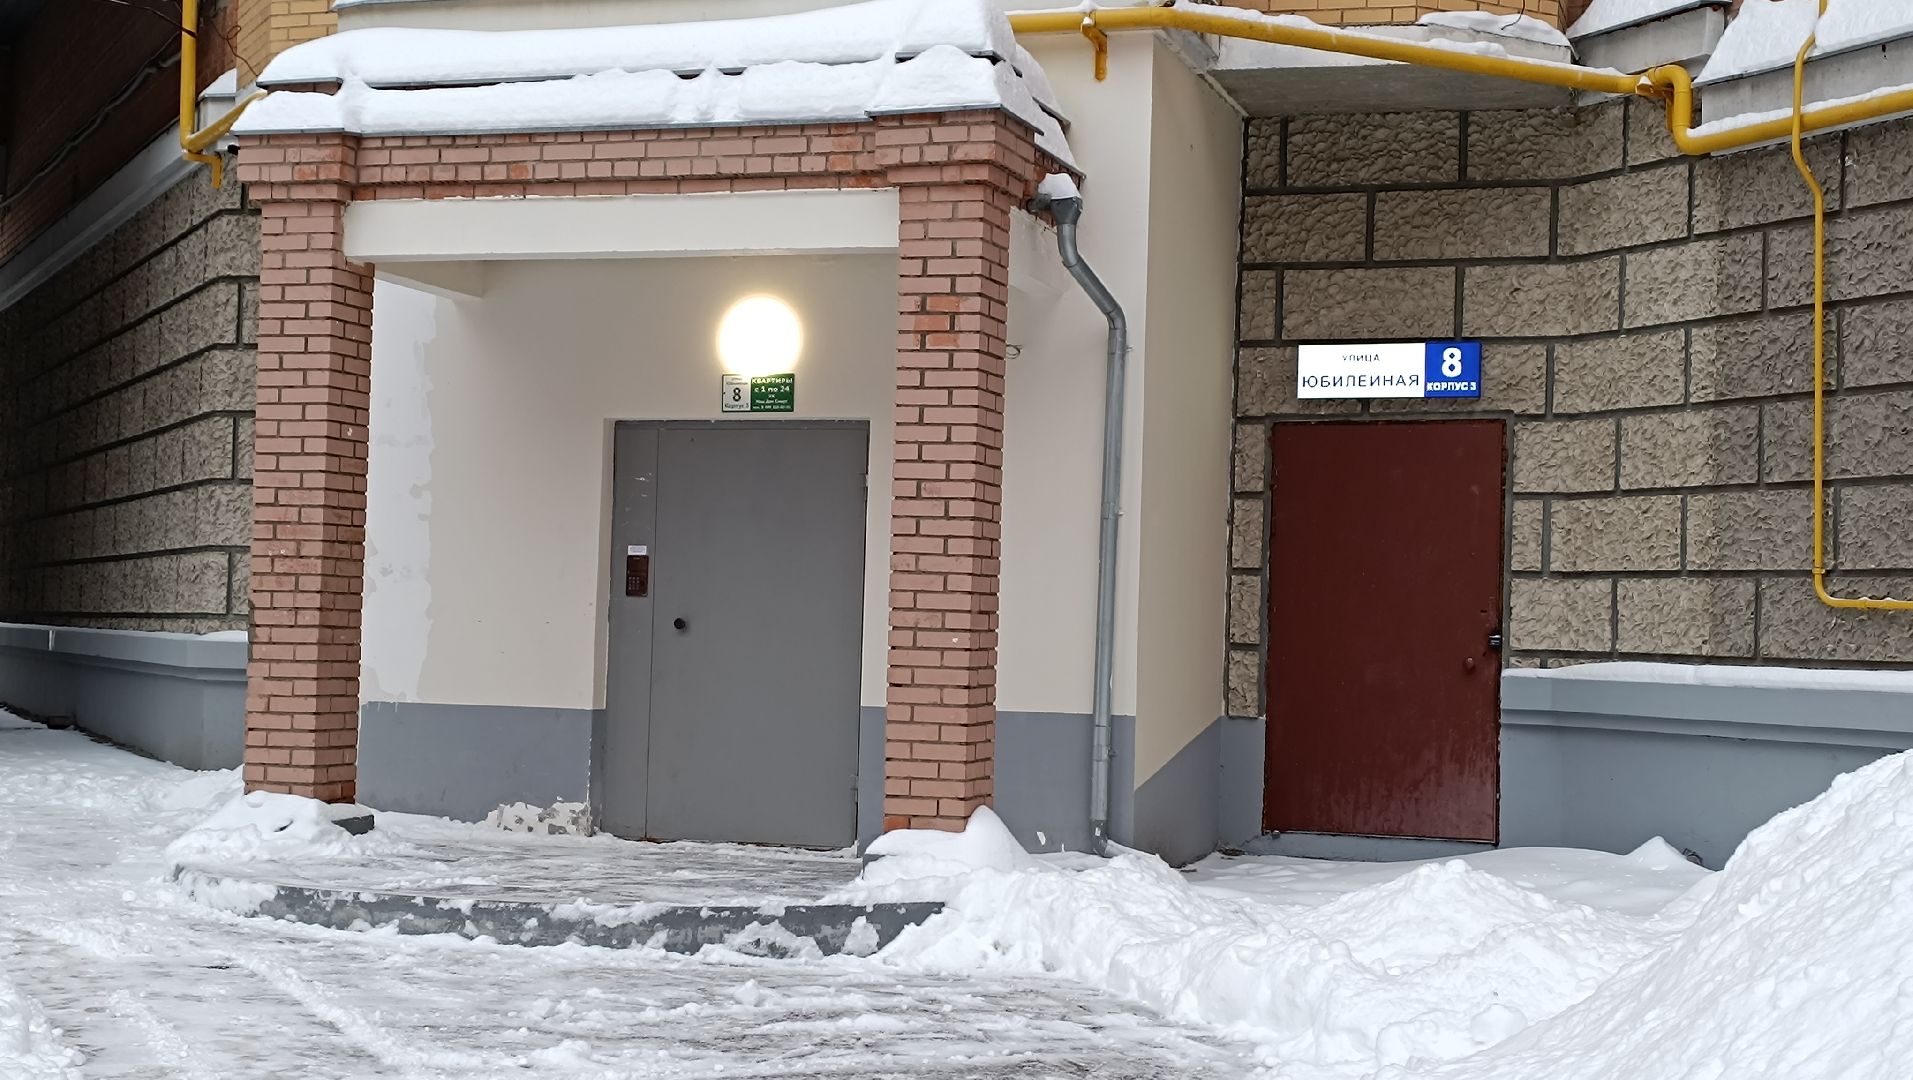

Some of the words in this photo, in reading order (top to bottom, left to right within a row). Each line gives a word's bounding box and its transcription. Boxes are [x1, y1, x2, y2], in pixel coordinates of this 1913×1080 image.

[1441, 347, 1463, 378] 8
[761, 385, 766, 393] 1
[780, 385, 790, 393] 24
[1426, 382, 1469, 392] КОРПУС
[1470, 382, 1478, 391] 3
[732, 387, 742, 402] 8
